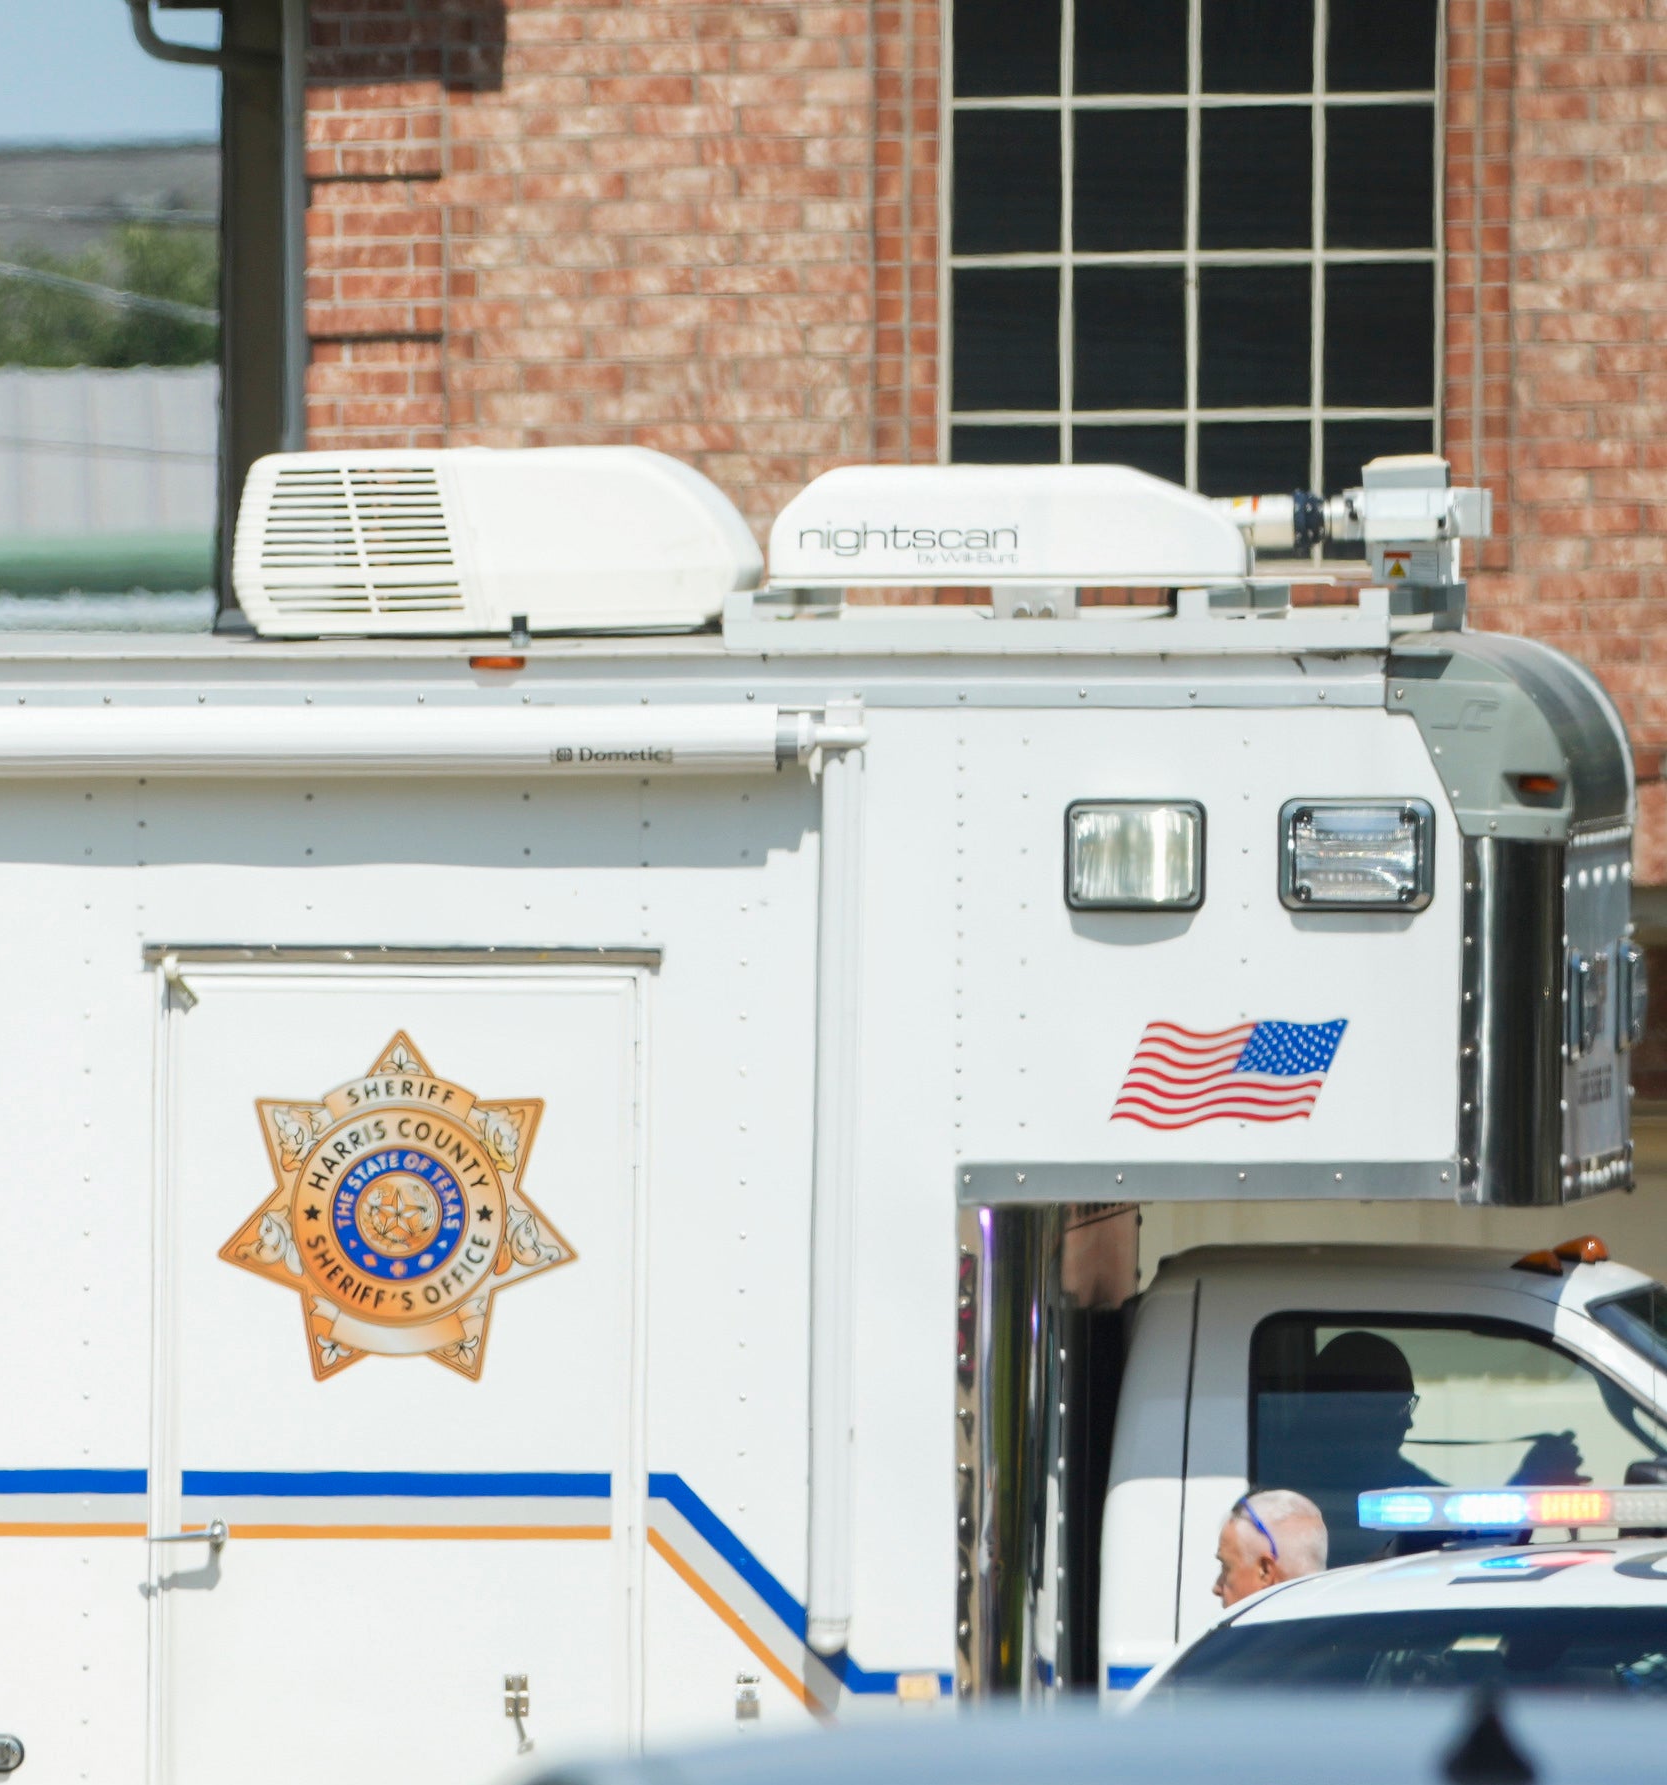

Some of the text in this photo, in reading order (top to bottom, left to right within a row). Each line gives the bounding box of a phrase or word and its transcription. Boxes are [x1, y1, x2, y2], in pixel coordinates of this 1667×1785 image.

[799, 520, 1019, 557] nightscan
[579, 746, 666, 762] Dometic
[347, 1080, 456, 1105] SHERIFF
[308, 1117, 490, 1192] HARRIS COUNTY
[336, 1151, 461, 1230] THE STATE OF TEXAS
[307, 1233, 491, 1312] SHERIFF'S OFFICE
